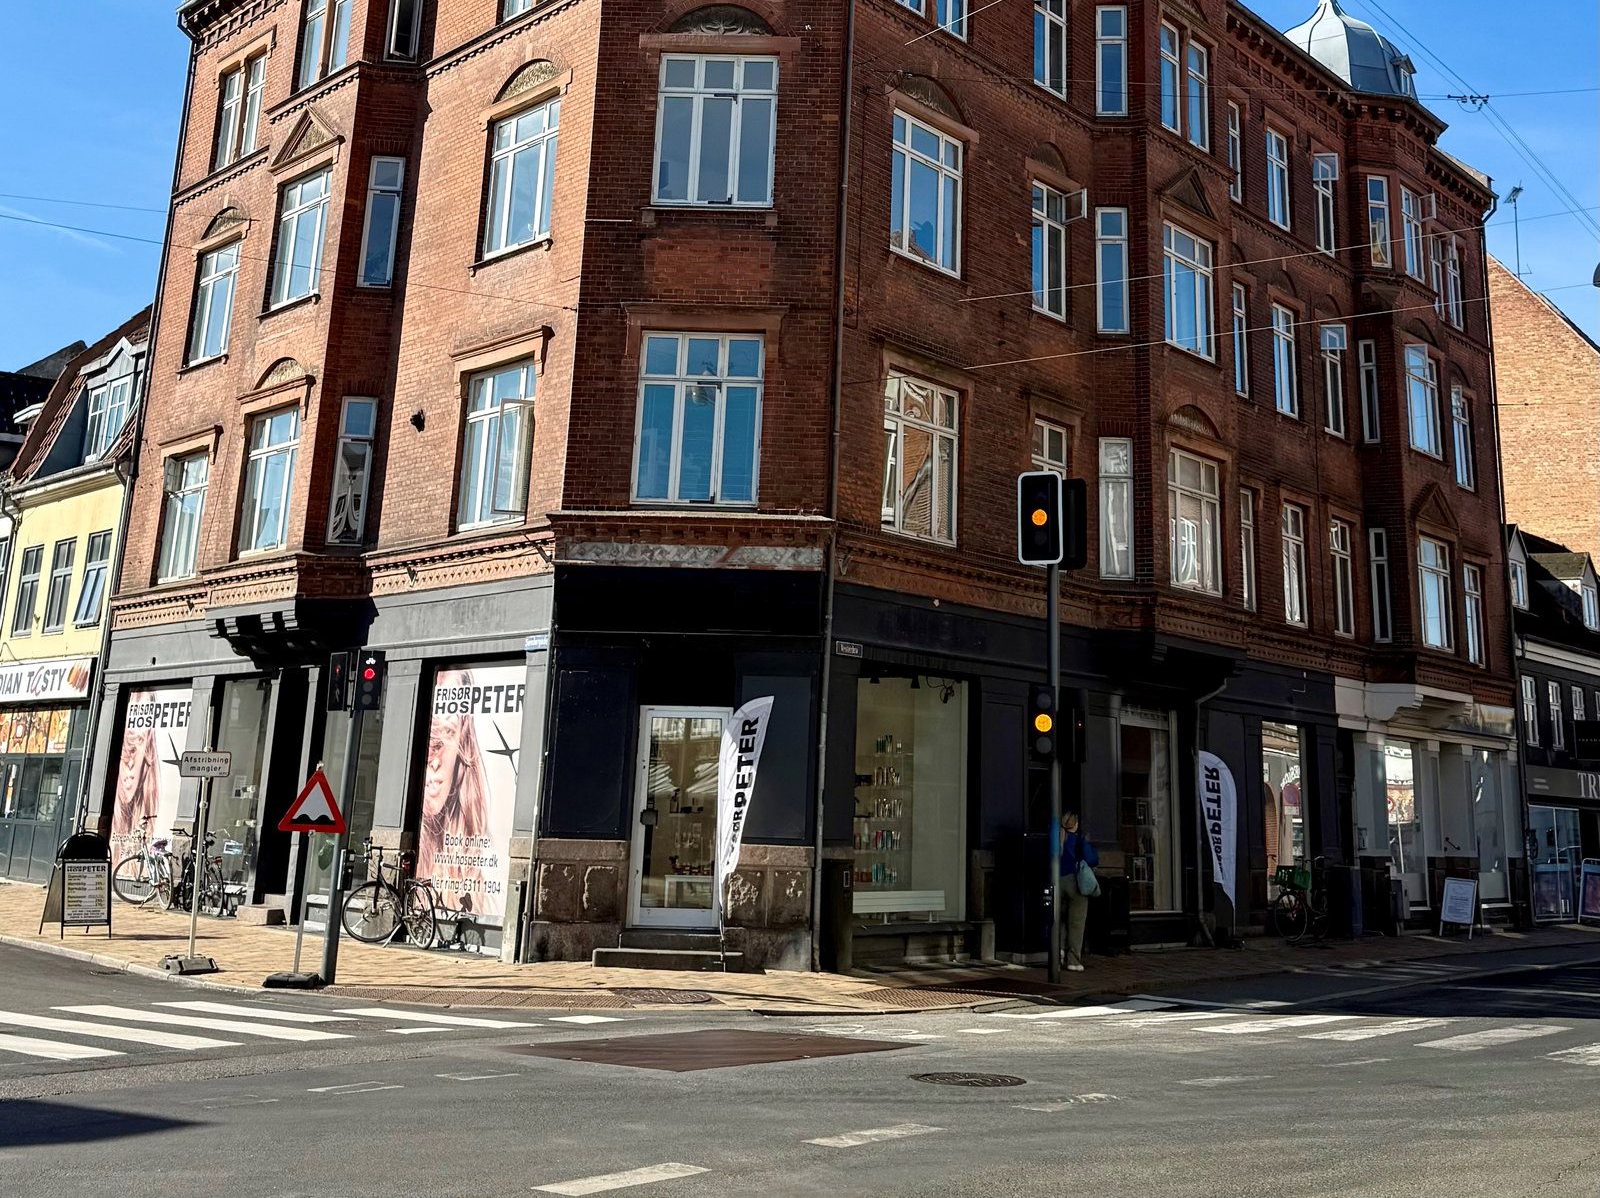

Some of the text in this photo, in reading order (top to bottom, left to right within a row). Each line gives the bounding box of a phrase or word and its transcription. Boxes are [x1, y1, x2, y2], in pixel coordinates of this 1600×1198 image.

[437, 687, 471, 701] FRISØR
[435, 702, 469, 714] HOS
[127, 716, 153, 728] HOS
[184, 756, 229, 764] Afstribning
[734, 715, 760, 808] PETER
[189, 765, 222, 773] mangler
[1577, 772, 1600, 800] TR
[444, 833, 491, 848] Book online:
[434, 852, 498, 867] www.hospeter.dk
[463, 879, 481, 892] 6311
[483, 880, 501, 894] 1904
